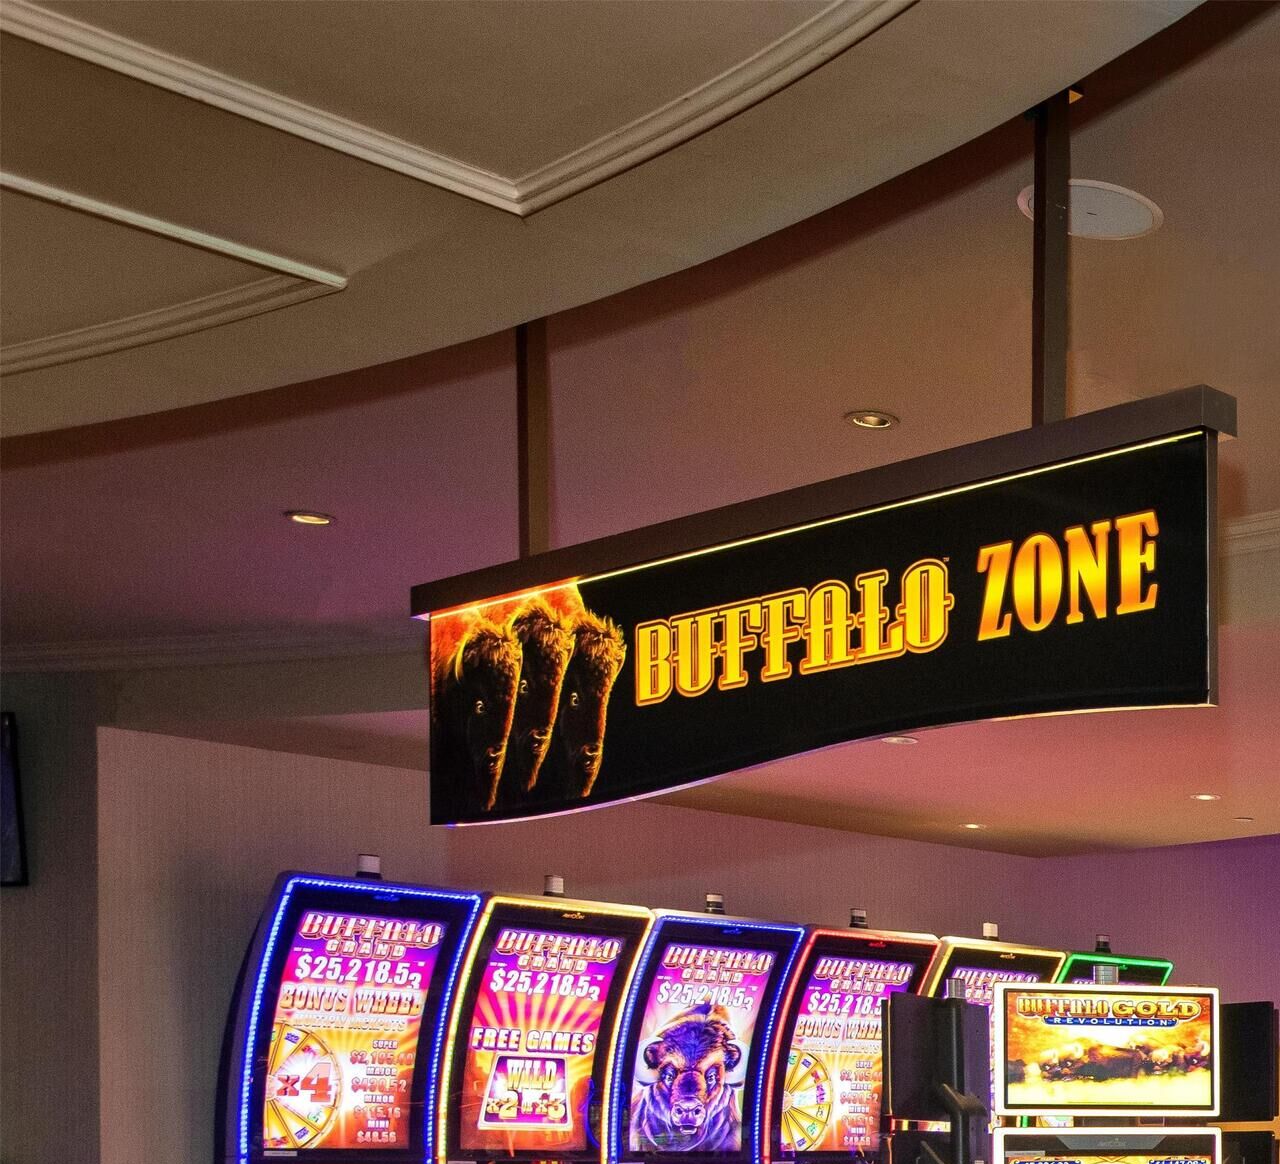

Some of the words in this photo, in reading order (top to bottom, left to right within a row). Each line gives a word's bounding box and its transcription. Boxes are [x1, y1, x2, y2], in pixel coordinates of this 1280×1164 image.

[635, 558, 953, 706] BUFFALO
[977, 509, 1160, 641] ZONE
[300, 912, 444, 949] BUFFALO
[326, 940, 406, 960] GRAND
[496, 929, 622, 963] BUFFALO
[518, 955, 588, 973] GRAND
[662, 946, 774, 975] BUFFALO
[814, 959, 913, 985] BUFFALO
[681, 969, 743, 984] GRAND
[280, 984, 347, 1011] BONUS
[1017, 997, 1110, 1018] BUFFALO
[1112, 999, 1201, 1019] GOLD
[796, 1017, 841, 1038] BONUS
[1054, 1017, 1169, 1026] REVOLUTION
[472, 1026, 521, 1050] FREE
[526, 1029, 595, 1054] GAMES
[366, 1067, 397, 1076] MAJOR
[506, 1060, 557, 1090] WILD
[364, 1094, 394, 1103] MINOR
